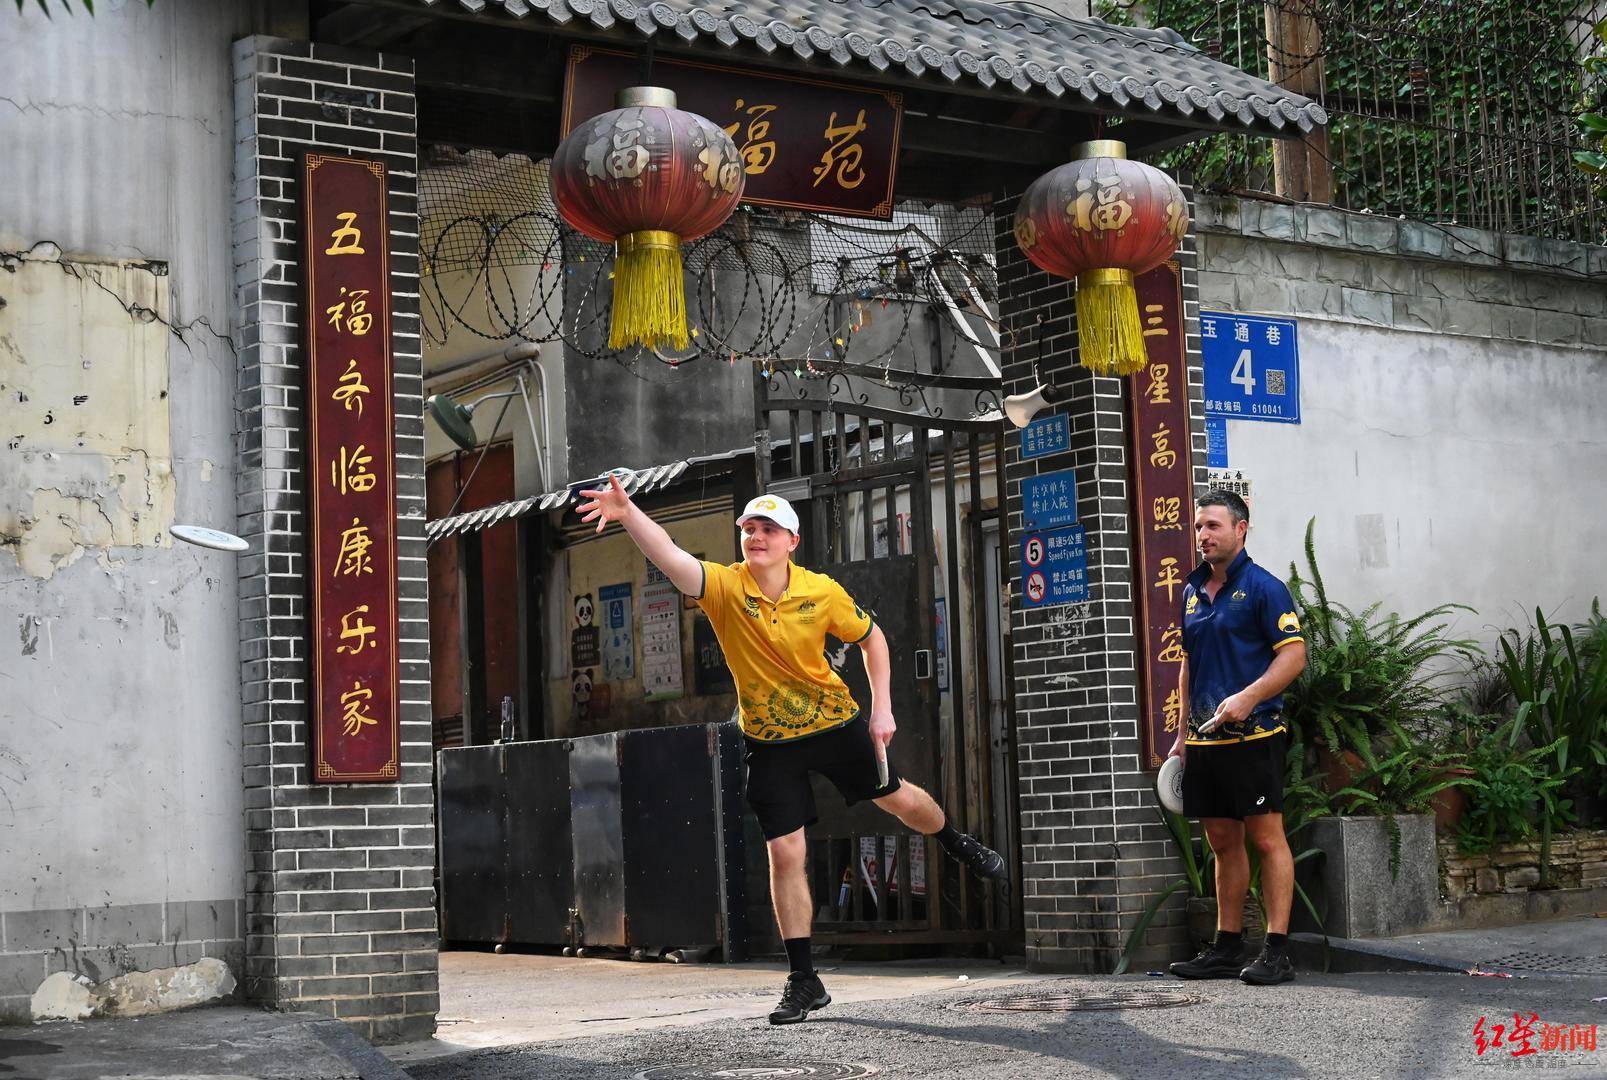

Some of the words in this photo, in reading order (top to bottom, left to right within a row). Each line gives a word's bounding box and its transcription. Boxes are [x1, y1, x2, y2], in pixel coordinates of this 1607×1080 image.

[1067, 174, 1133, 231] 福
[1202, 318, 1282, 347] 玉通巷
[1230, 349, 1256, 396] 4
[1205, 399, 1242, 413] 邮政编码
[1252, 403, 1282, 414] 610041
[1027, 434, 1063, 452] 运行之中
[325, 211, 379, 738] 五福齐临康乐家
[1032, 481, 1068, 498] 共享单车
[1032, 495, 1069, 514] 禁止入院
[1047, 533, 1083, 549] 限速5公里
[1030, 541, 1039, 563] 5
[1048, 551, 1065, 562] Speed
[1052, 568, 1083, 583] 禁止鸣笛
[1053, 586, 1062, 596] No
[1062, 583, 1084, 595] Tooting
